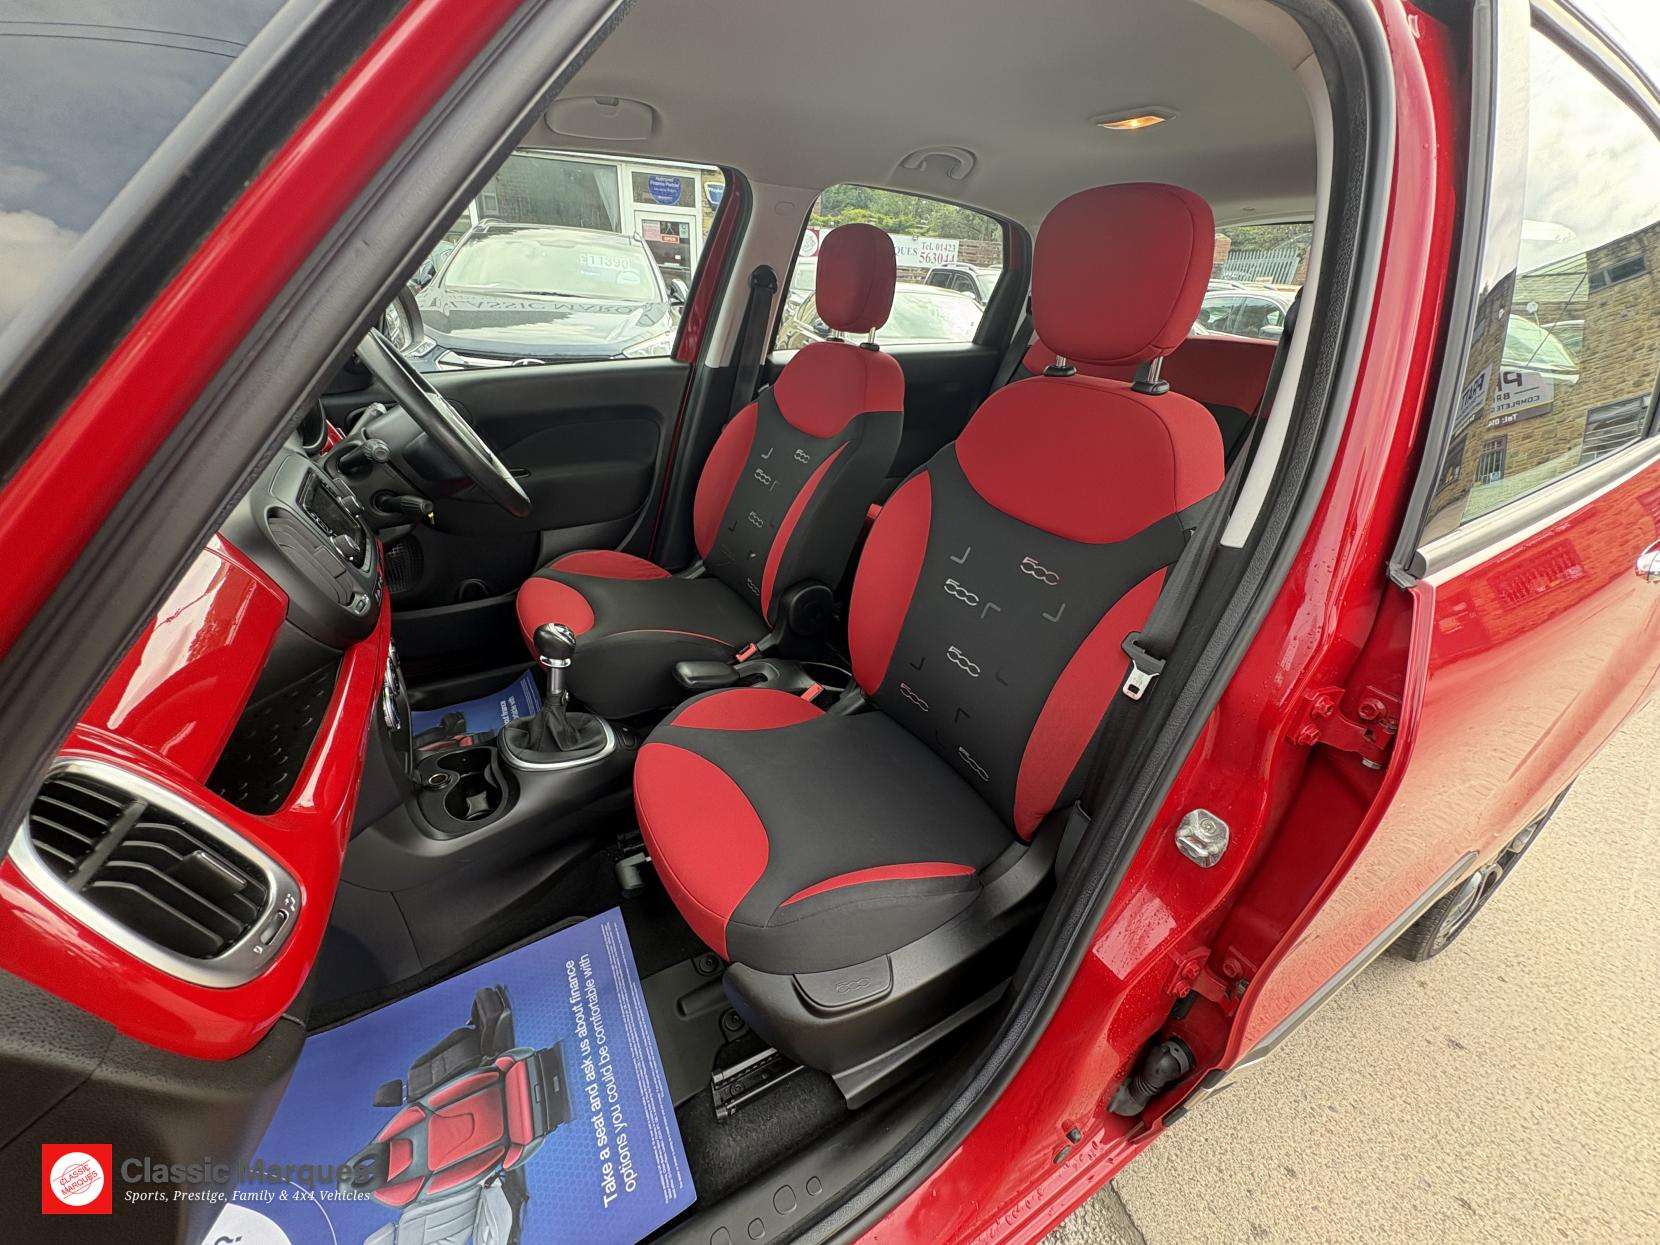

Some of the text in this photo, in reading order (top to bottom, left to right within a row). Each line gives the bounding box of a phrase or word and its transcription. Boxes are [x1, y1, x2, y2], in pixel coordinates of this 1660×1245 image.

[1020, 556, 1060, 586] 500
[944, 578, 980, 607] 500
[946, 645, 981, 677] 500
[565, 959, 618, 1208] Take a seat and ask us about finance
[579, 953, 638, 1193] options you could be comfortable with
